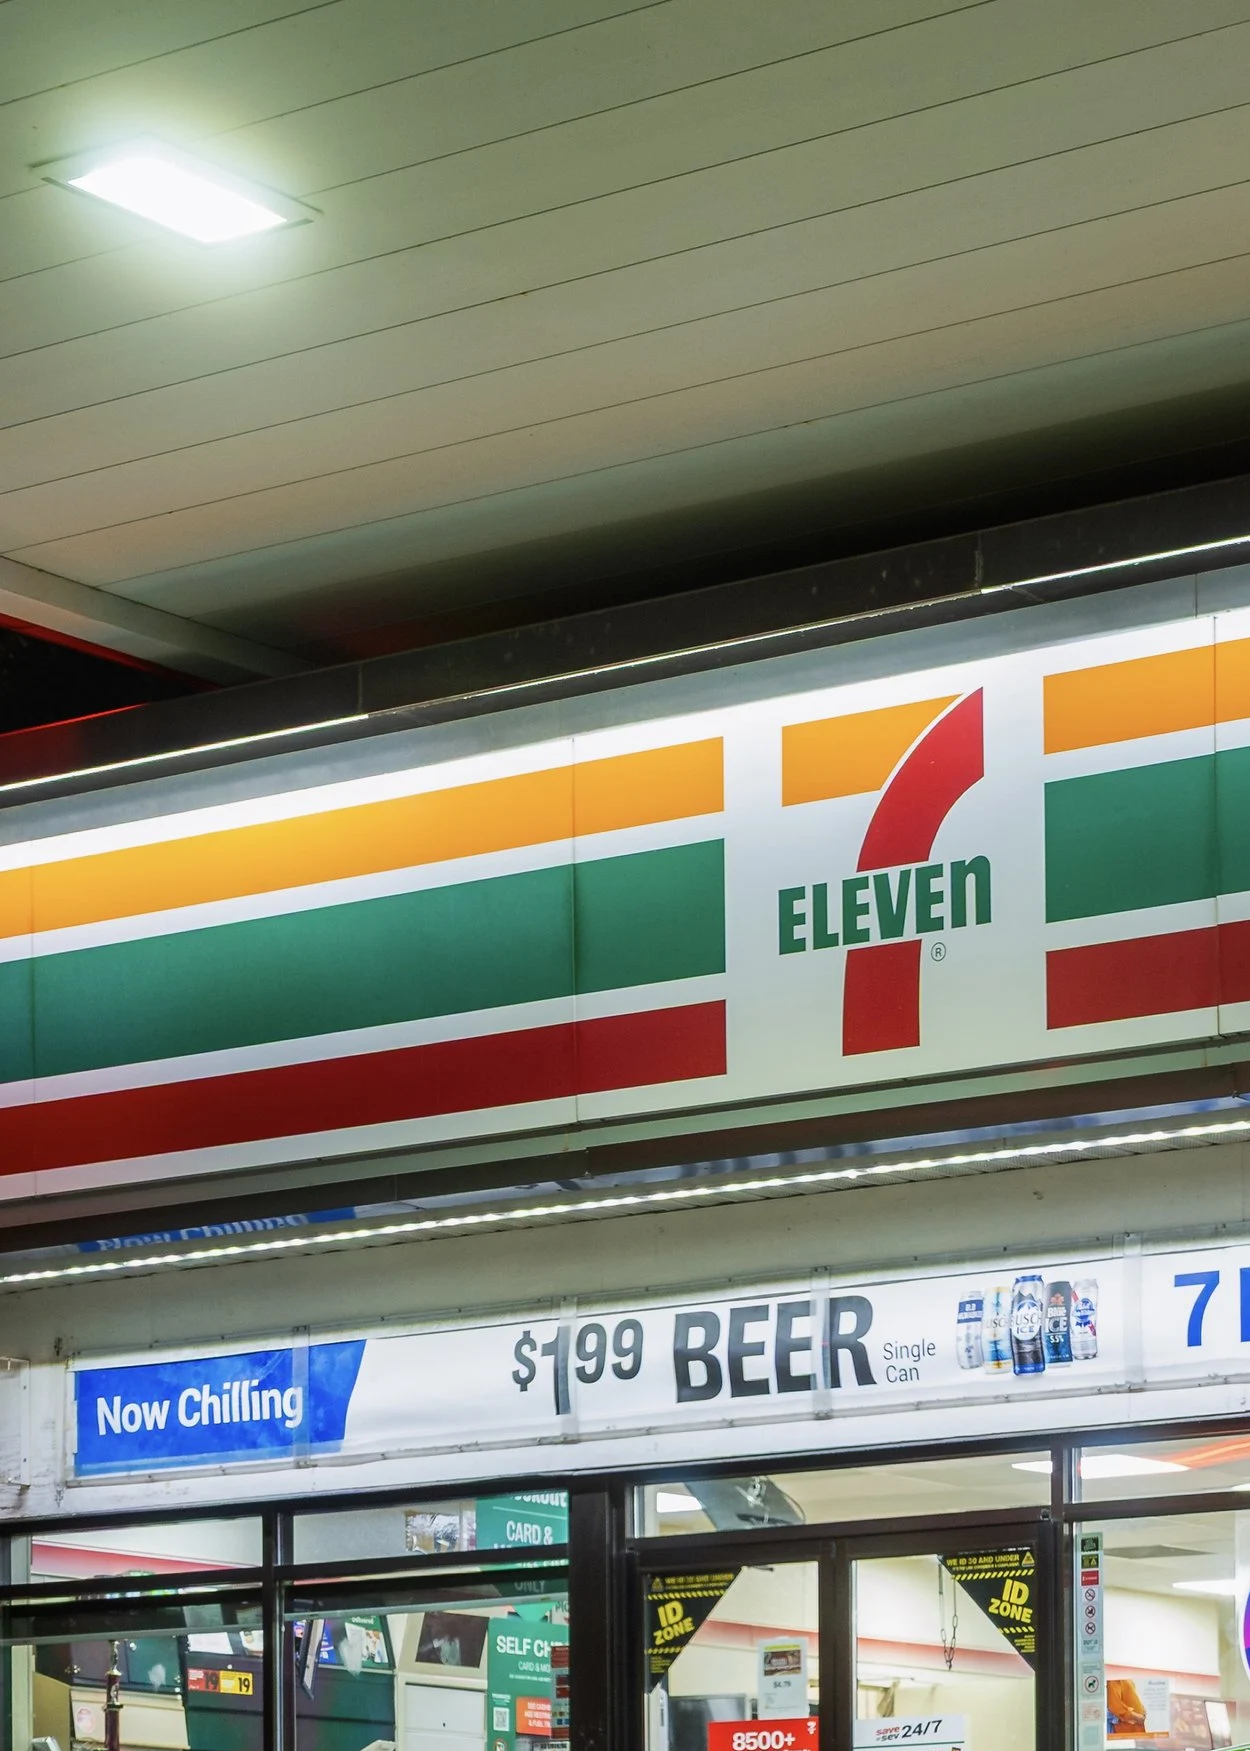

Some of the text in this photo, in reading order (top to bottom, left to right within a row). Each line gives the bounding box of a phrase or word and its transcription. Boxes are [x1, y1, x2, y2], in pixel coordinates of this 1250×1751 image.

[782, 686, 985, 1057] 7
[1174, 1269, 1221, 1348] 7
[674, 1294, 878, 1404] BEER
[882, 1338, 937, 1363] Single
[886, 1364, 921, 1384] Can
[96, 1378, 304, 1436] Now Chilling
[506, 1520, 553, 1546] CARD &
[995, 1553, 1020, 1563] UNDER
[1002, 1578, 1030, 1605] ID
[658, 1600, 684, 1628] ID
[988, 1597, 1033, 1624] ZONE
[653, 1617, 695, 1645] ZONE
[496, 1635, 532, 1656] SELF
[238, 1677, 250, 1693] 19
[732, 1730, 796, 1751] 8500+
[876, 1726, 900, 1736] save
[901, 1719, 943, 1739] 24/7
